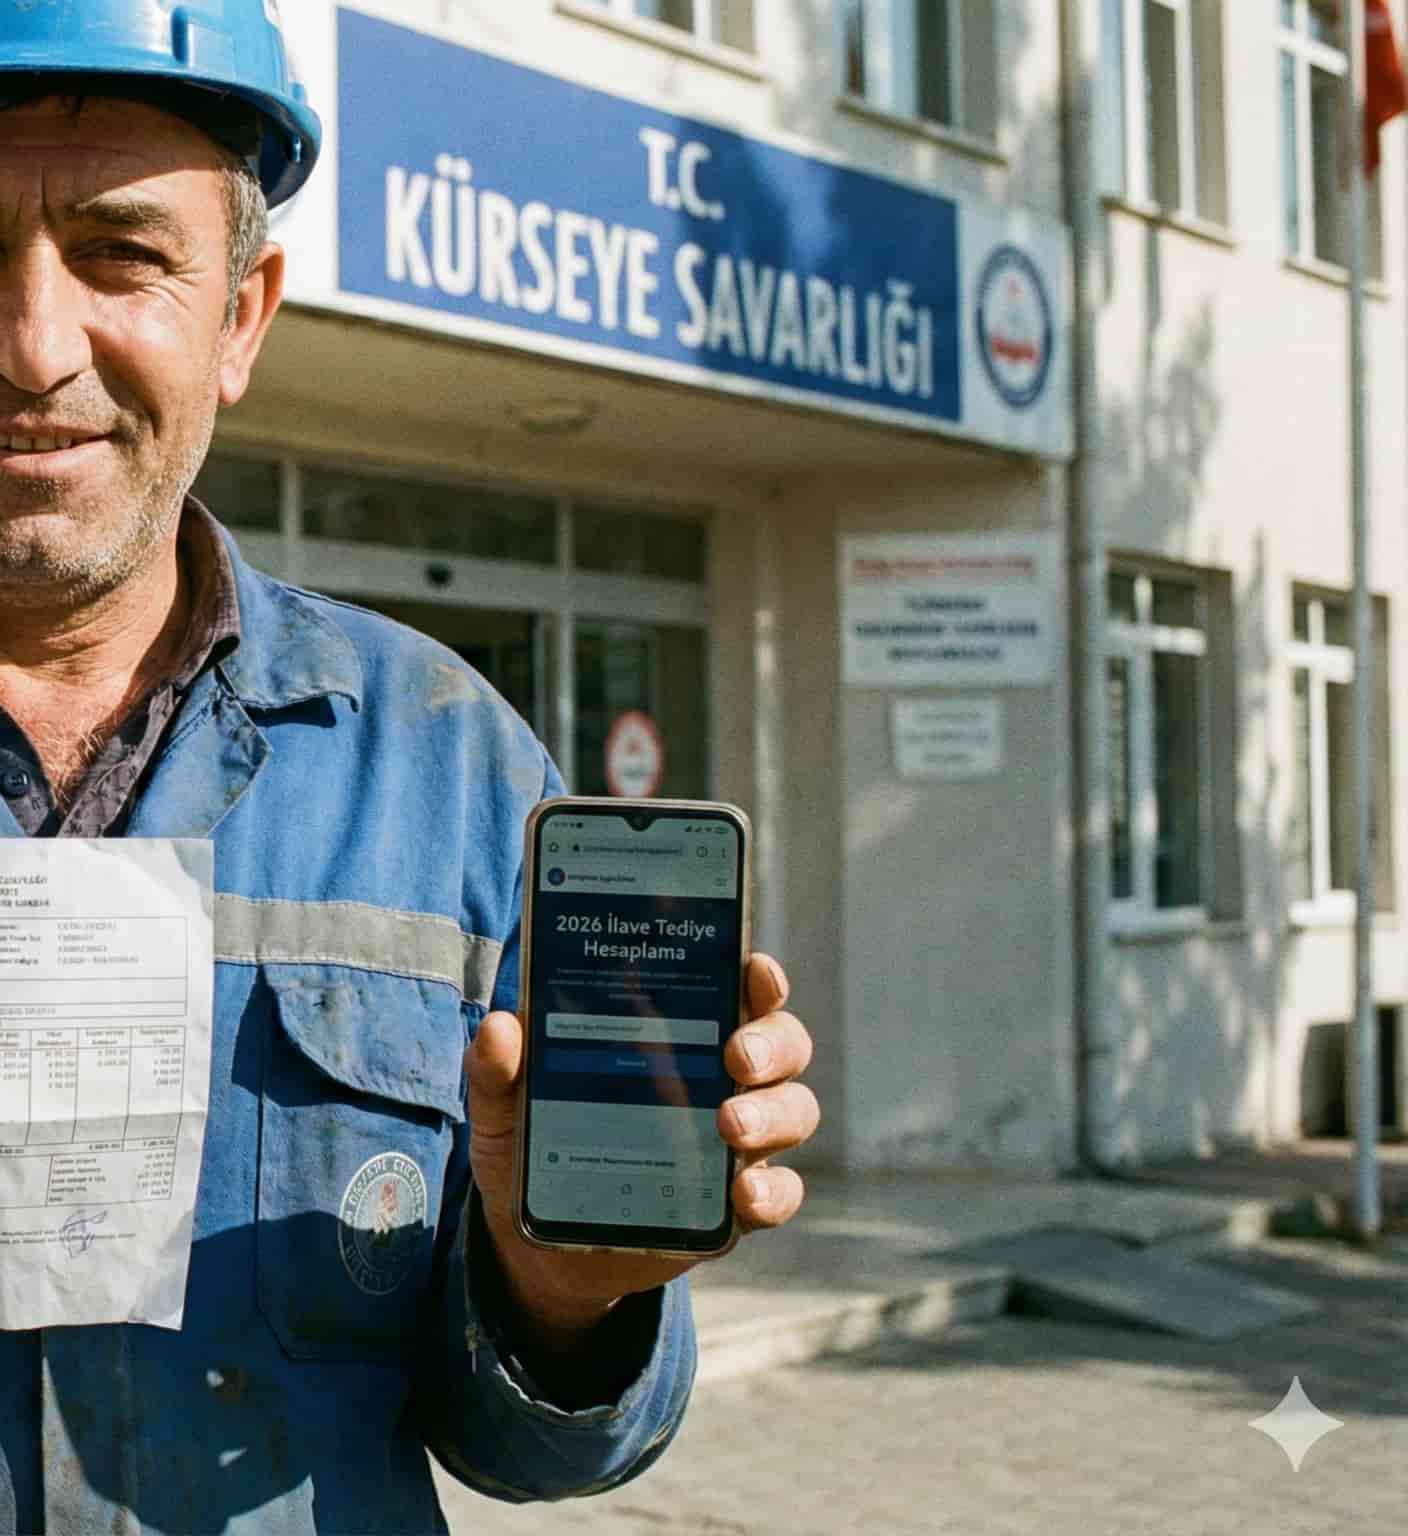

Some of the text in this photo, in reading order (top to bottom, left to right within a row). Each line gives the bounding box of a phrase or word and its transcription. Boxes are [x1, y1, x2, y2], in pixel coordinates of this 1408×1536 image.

[639, 126, 724, 220] T.C.
[385, 152, 934, 399] KÜRSEYE SAVARLIĞI
[556, 912, 716, 942] 2026 İlave Tediye
[584, 939, 686, 963] Hesaplama
